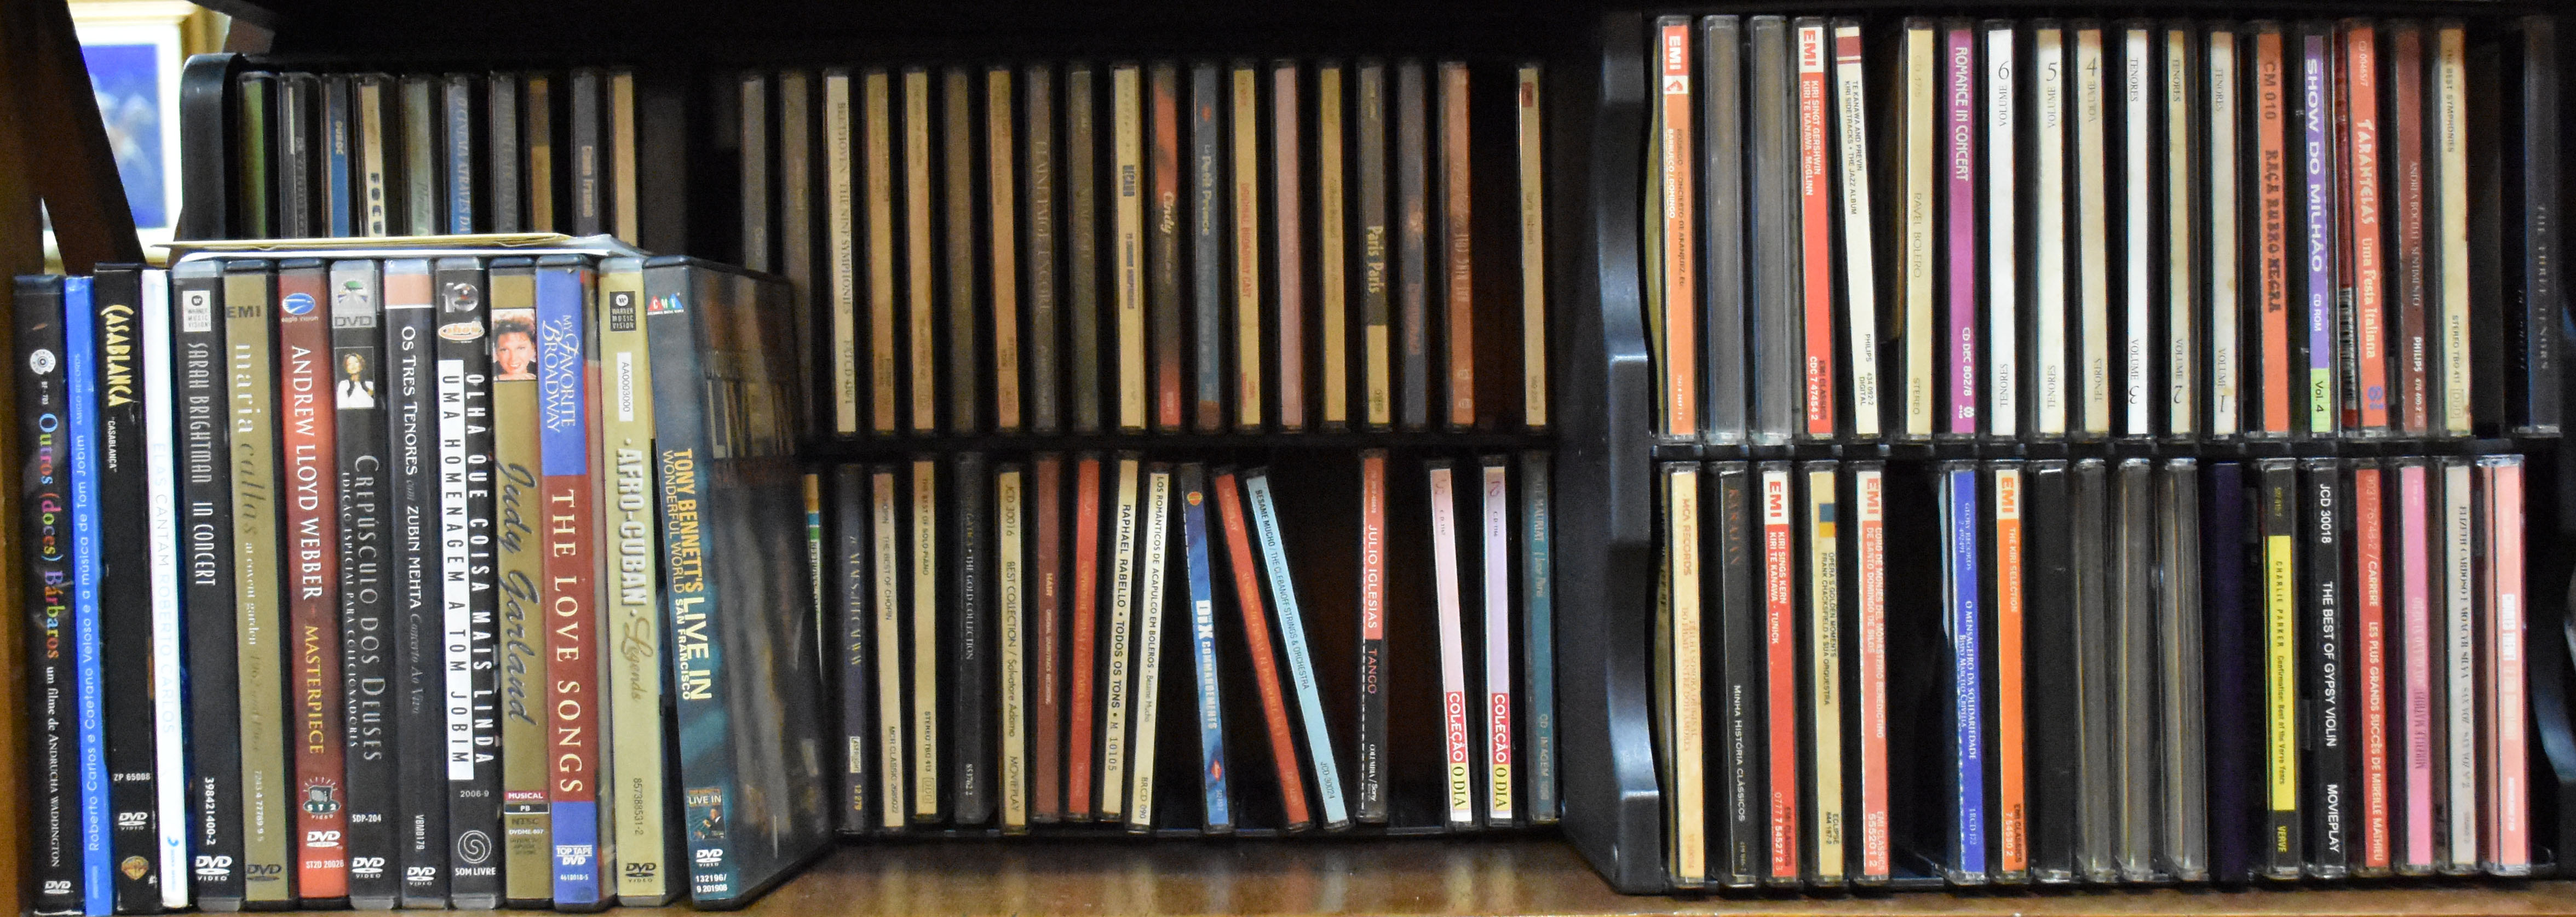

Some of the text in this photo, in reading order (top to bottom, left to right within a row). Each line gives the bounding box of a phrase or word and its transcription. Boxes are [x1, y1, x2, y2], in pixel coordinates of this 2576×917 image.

[1804, 31, 1816, 66] EMI
[1999, 61, 2009, 79] 6
[1956, 47, 1968, 181] ROMANCE IN CONCERT
[1201, 156, 1212, 187] Petit
[2307, 59, 2322, 271] SHOW DO MILHÃO
[1160, 192, 1175, 234] Cindy
[1201, 191, 1211, 236] Prince
[2357, 119, 2378, 358] TARANTELAS Uma Festa Italiana
[841, 240, 852, 314] SYMPHONIES
[1368, 226, 1383, 293] Paris Paris
[228, 307, 261, 318] EMI
[101, 305, 134, 406] CASABLANCA
[542, 321, 563, 432] BROADWAY
[557, 316, 579, 427] MY FAVORITE
[622, 362, 630, 411] AA0003000
[2315, 381, 2324, 412] Vol. 4
[76, 435, 87, 477] Jobim
[189, 343, 216, 586] SARAH BRIGHTMAN IN CONCERT
[292, 346, 323, 601] ANDREW LLOYD WEBBER
[79, 481, 88, 508] Tom
[79, 514, 88, 531] de
[403, 326, 422, 662] OS TRES TENORES ZUBIN MEHTA Concerto
[663, 451, 685, 593] WONDERFUL WORLD
[674, 449, 704, 592] TONY BENNETT'S
[1153, 495, 1164, 551] ROMÂNTICOS
[2002, 478, 2014, 512] EMI
[2320, 484, 2332, 543] JCD 30018
[81, 537, 92, 586] música
[154, 444, 175, 733] ELAS CANTAM ROBERTO CARLOS
[443, 376, 469, 763] UMA HOMENAGEM A TOM JOBIM
[467, 375, 495, 762] OLHA QUE COISA MAIS LINDA
[495, 463, 540, 726] Judy Garland
[617, 448, 653, 701] AFRO-CUBAN Legends
[1151, 568, 1159, 613] ACAPULCO
[1153, 553, 1159, 563] DE
[1256, 490, 1309, 689] BESAME MUCHO CLEBANOFF STRINGS ORCHESTRA
[1367, 524, 1378, 628] JULIO IGLESIAS
[39, 414, 65, 867] Outros (doces) Bárbaros um filme de ANDRUCHA WADDINGTON
[82, 619, 93, 663] Veloso
[355, 456, 386, 760] CREPÚSCULO DOS DEUSES
[553, 489, 583, 793] THE LOVE SONGS
[1112, 505, 1131, 708] RAPHAEL RABELLO TODOS OS TONS
[1149, 616, 1157, 628] EM
[675, 598, 691, 700] SAN FRANCISCO
[683, 597, 712, 700] LIVE IN
[1147, 631, 1156, 668] BOLEROS
[1201, 641, 1217, 729] COMMANDEMENTS
[1367, 649, 1377, 694] TANGO
[2322, 581, 2337, 746] THE BEST OF GYPSY VIOLIN
[84, 669, 96, 729] Caetano
[304, 626, 324, 754] MASTERPIECE
[88, 749, 98, 792] Carlos
[1450, 694, 1465, 806] COLEÇÃO O DIA
[1492, 695, 1507, 807] COLEÇÃO O DIA
[1735, 720, 1744, 765] HISTÓRIA
[2369, 622, 2383, 860] LES PLUS GRANDS SUCCÈS DE MIREILLE MATHIEU
[89, 796, 100, 851] Roberto
[1737, 769, 1745, 821] CLÁSSICOS
[2327, 784, 2339, 852] MOVIEPLAY
[456, 867, 496, 875] SOM LIVRE
[2278, 826, 2287, 852] VERVE
